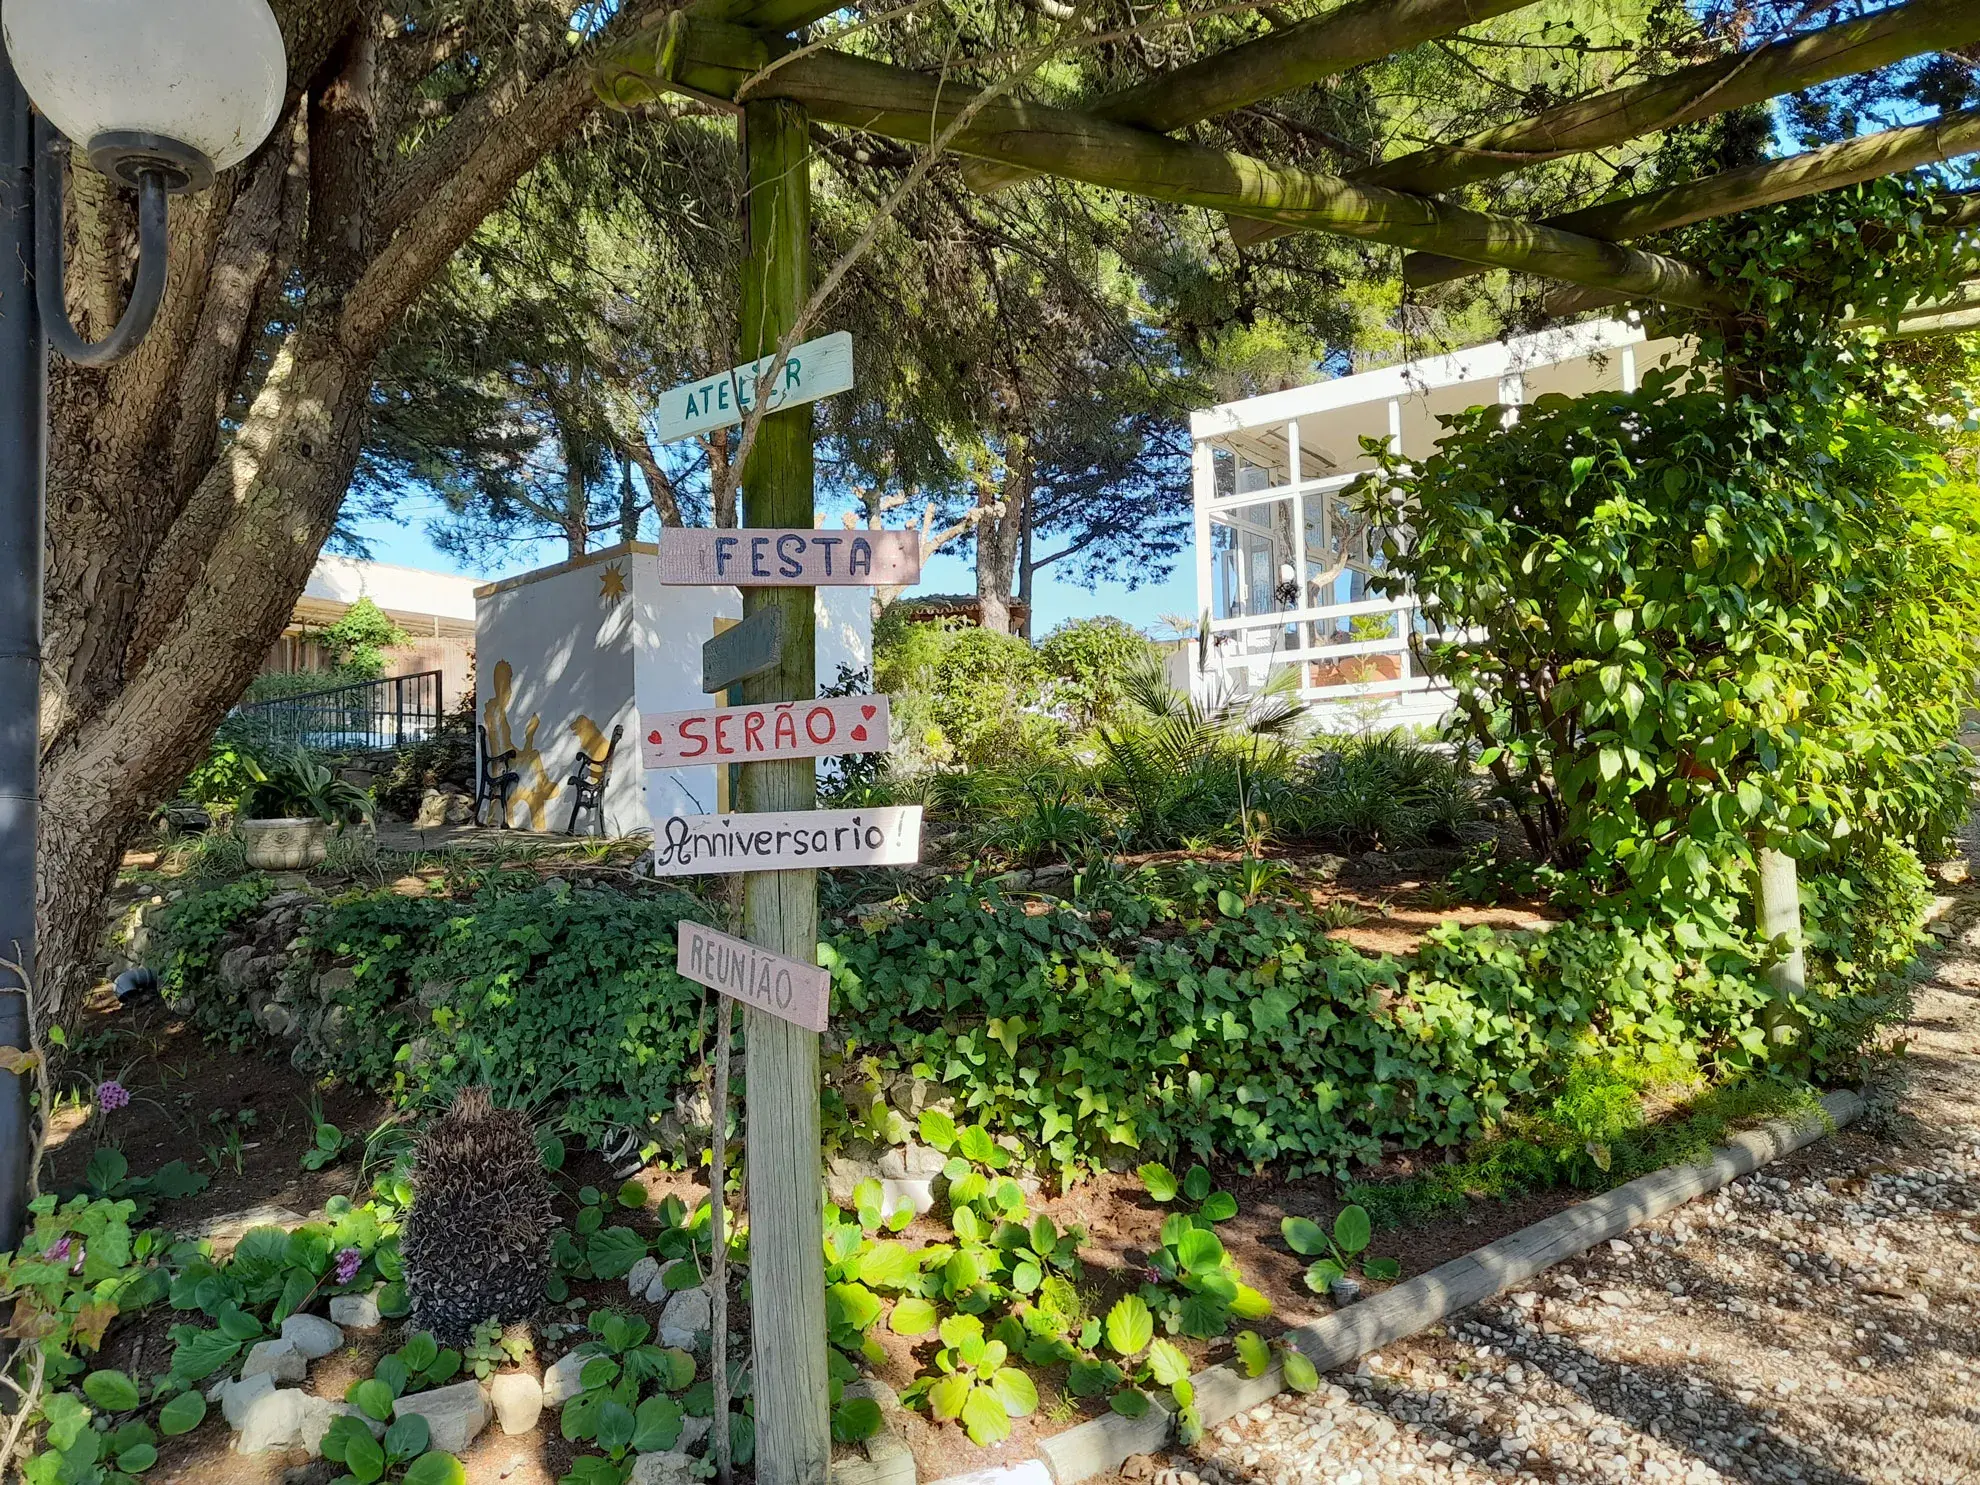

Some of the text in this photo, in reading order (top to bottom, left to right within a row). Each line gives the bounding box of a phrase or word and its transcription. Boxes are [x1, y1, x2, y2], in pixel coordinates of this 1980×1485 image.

[685, 357, 801, 420] ATELR
[715, 533, 872, 578] FESTA
[679, 702, 836, 757] SERÃO
[690, 934, 792, 1010] REUNIÃO
